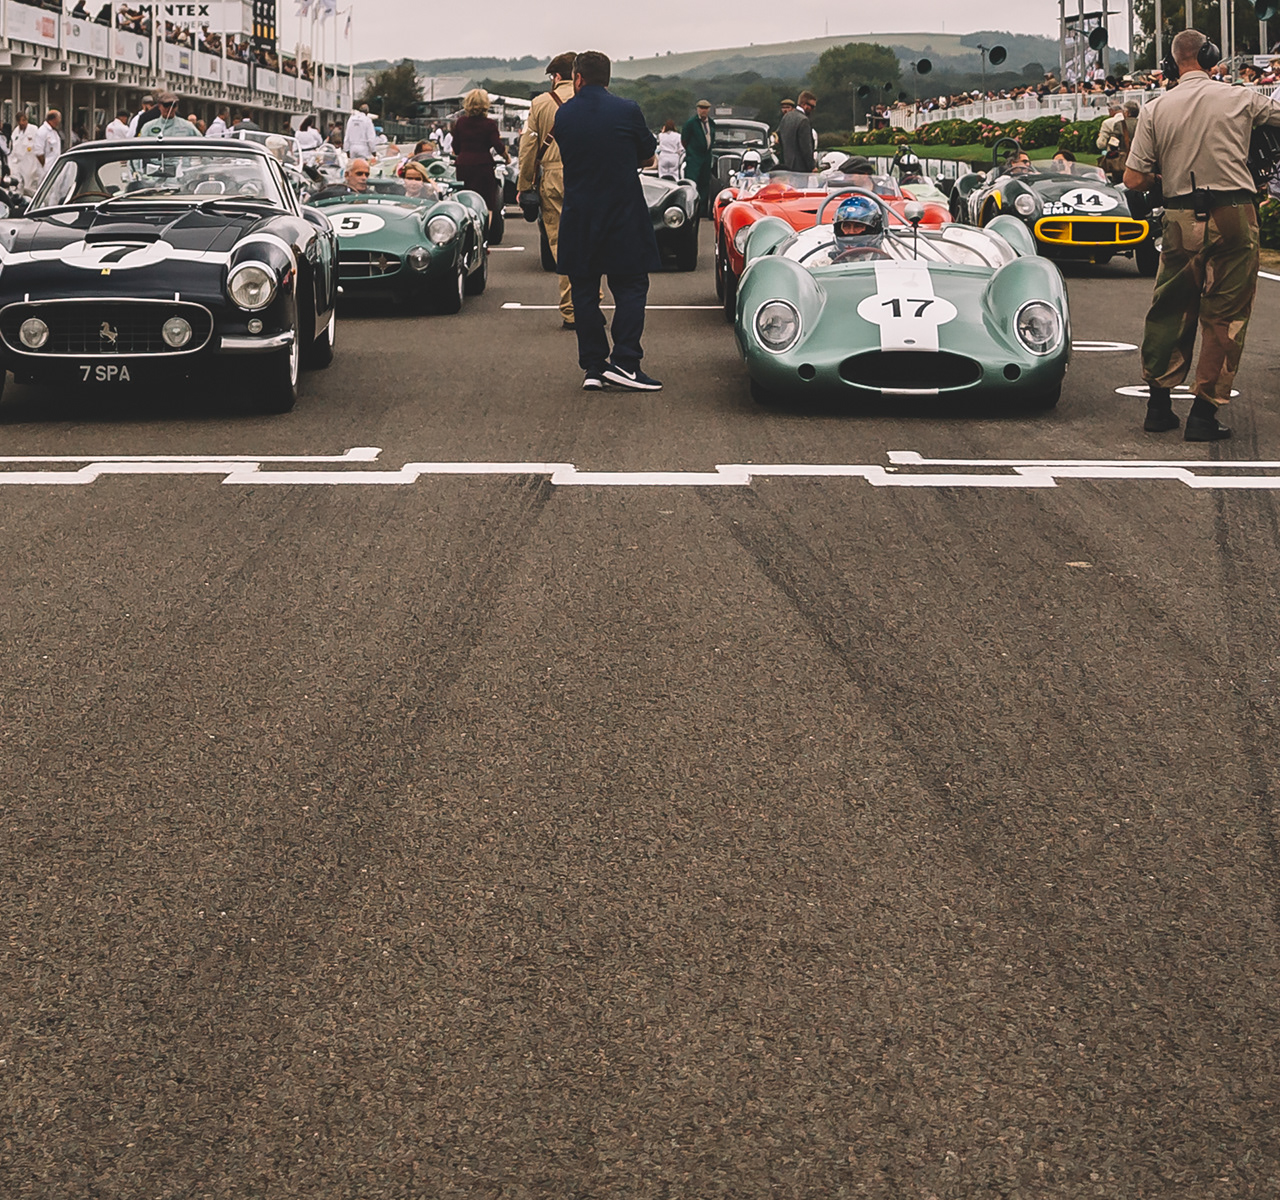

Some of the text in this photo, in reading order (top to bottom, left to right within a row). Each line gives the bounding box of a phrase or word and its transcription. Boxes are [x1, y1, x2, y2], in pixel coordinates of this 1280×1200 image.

[139, 4, 209, 16] MINTEX
[32, 56, 39, 67] 7
[60, 62, 67, 72] 8
[87, 66, 93, 76] 9
[104, 71, 116, 80] 10
[1073, 193, 1104, 206] 14
[1043, 206, 1074, 215] EMU
[340, 216, 361, 230] 5
[91, 244, 148, 263] 7
[881, 298, 934, 318] 17
[79, 365, 131, 382] 7 SPA
